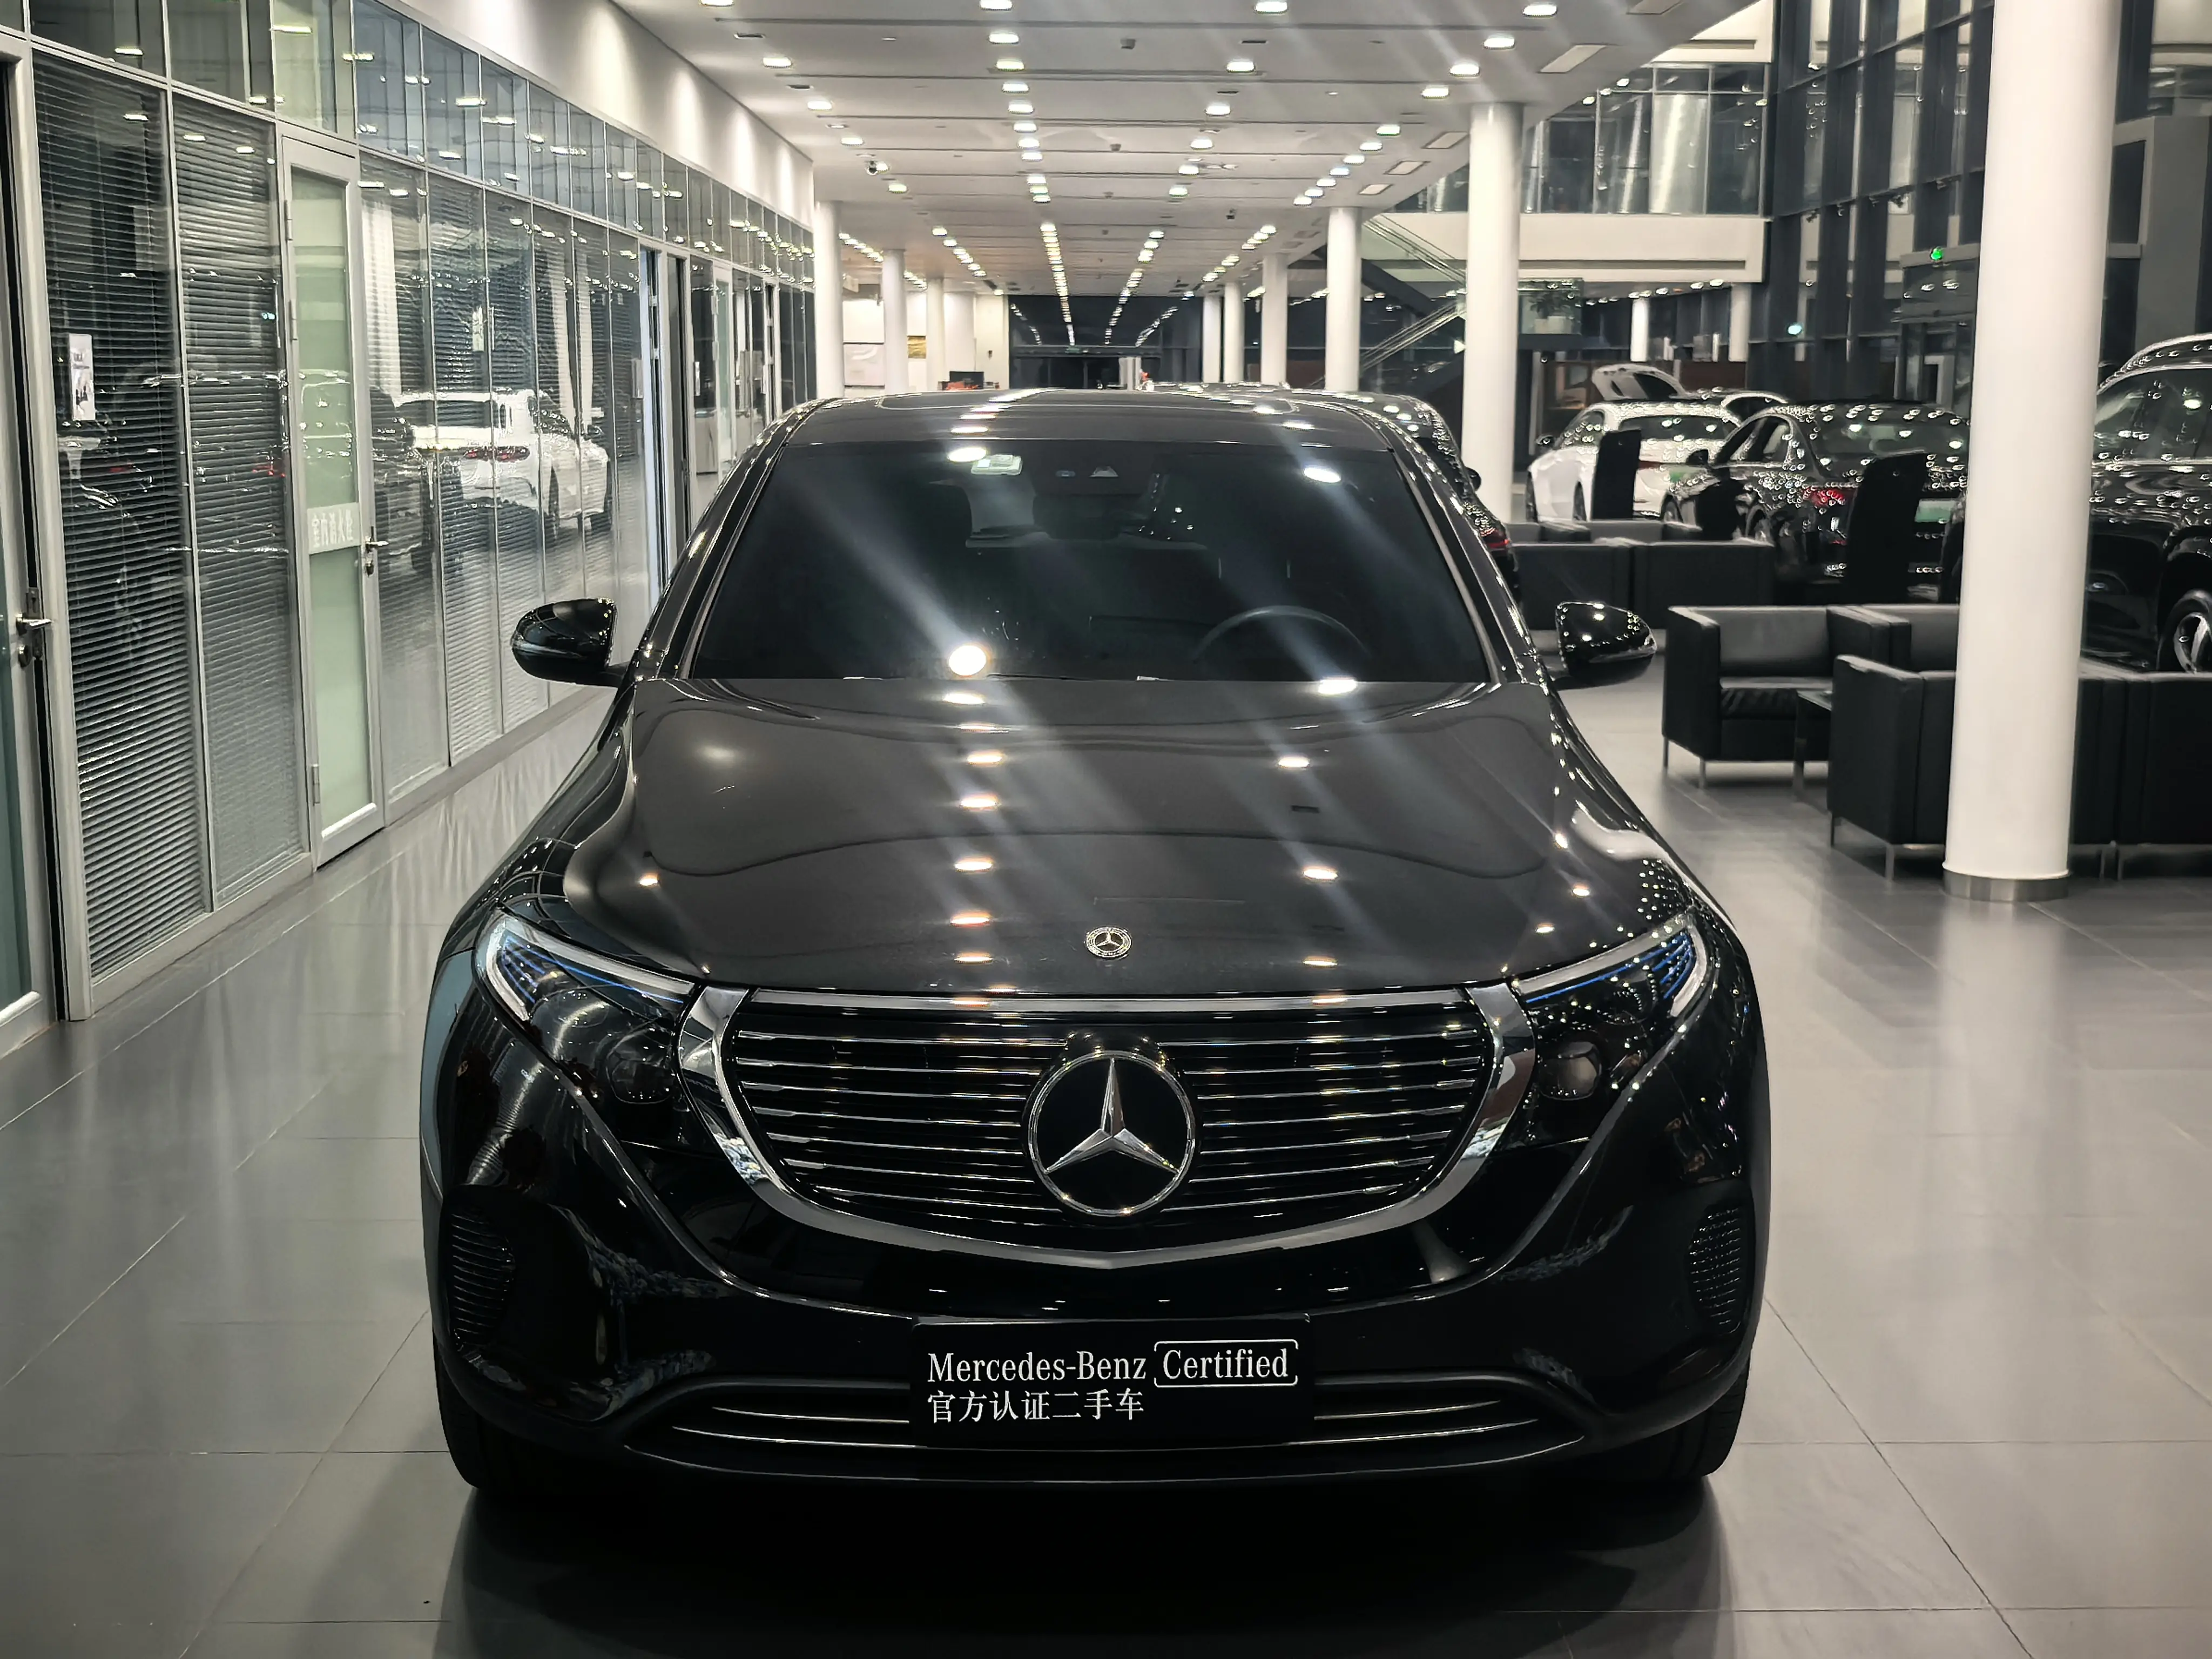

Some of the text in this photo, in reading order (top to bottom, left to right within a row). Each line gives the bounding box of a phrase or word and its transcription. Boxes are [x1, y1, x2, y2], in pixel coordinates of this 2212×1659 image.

[927, 1348, 1289, 1382] Mercedes-Benz Certified
[927, 1387, 1144, 1424] 官方认证二手车
